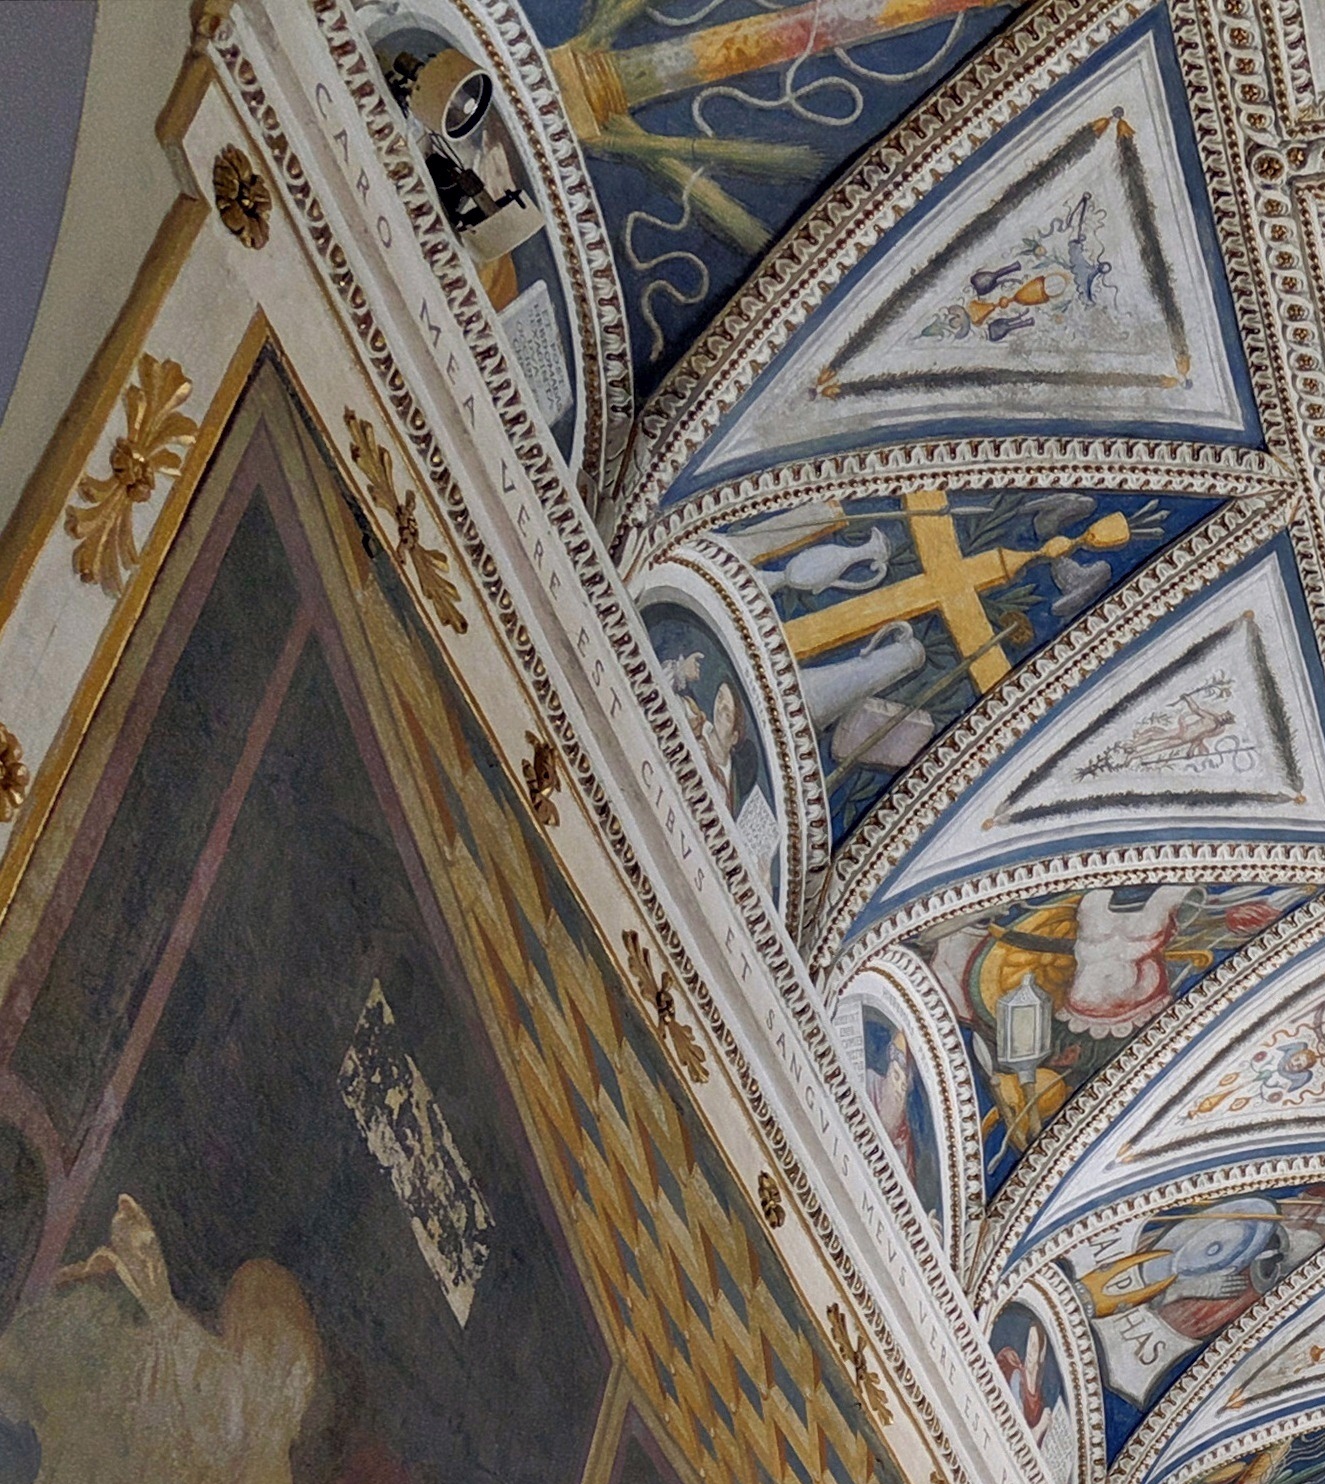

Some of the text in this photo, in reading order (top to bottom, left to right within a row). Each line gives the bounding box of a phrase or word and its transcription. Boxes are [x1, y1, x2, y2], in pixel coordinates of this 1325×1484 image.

[315, 82, 393, 249] CARO
[419, 297, 477, 429] MEA
[500, 457, 562, 602] VERE
[577, 625, 623, 719] EST
[640, 757, 706, 894] CIBVS
[724, 925, 753, 983] ET
[766, 1007, 851, 1179] SANGVIS
[861, 1196, 908, 1288] MEVS
[917, 1300, 959, 1386] VERE
[962, 1393, 994, 1453] EST
